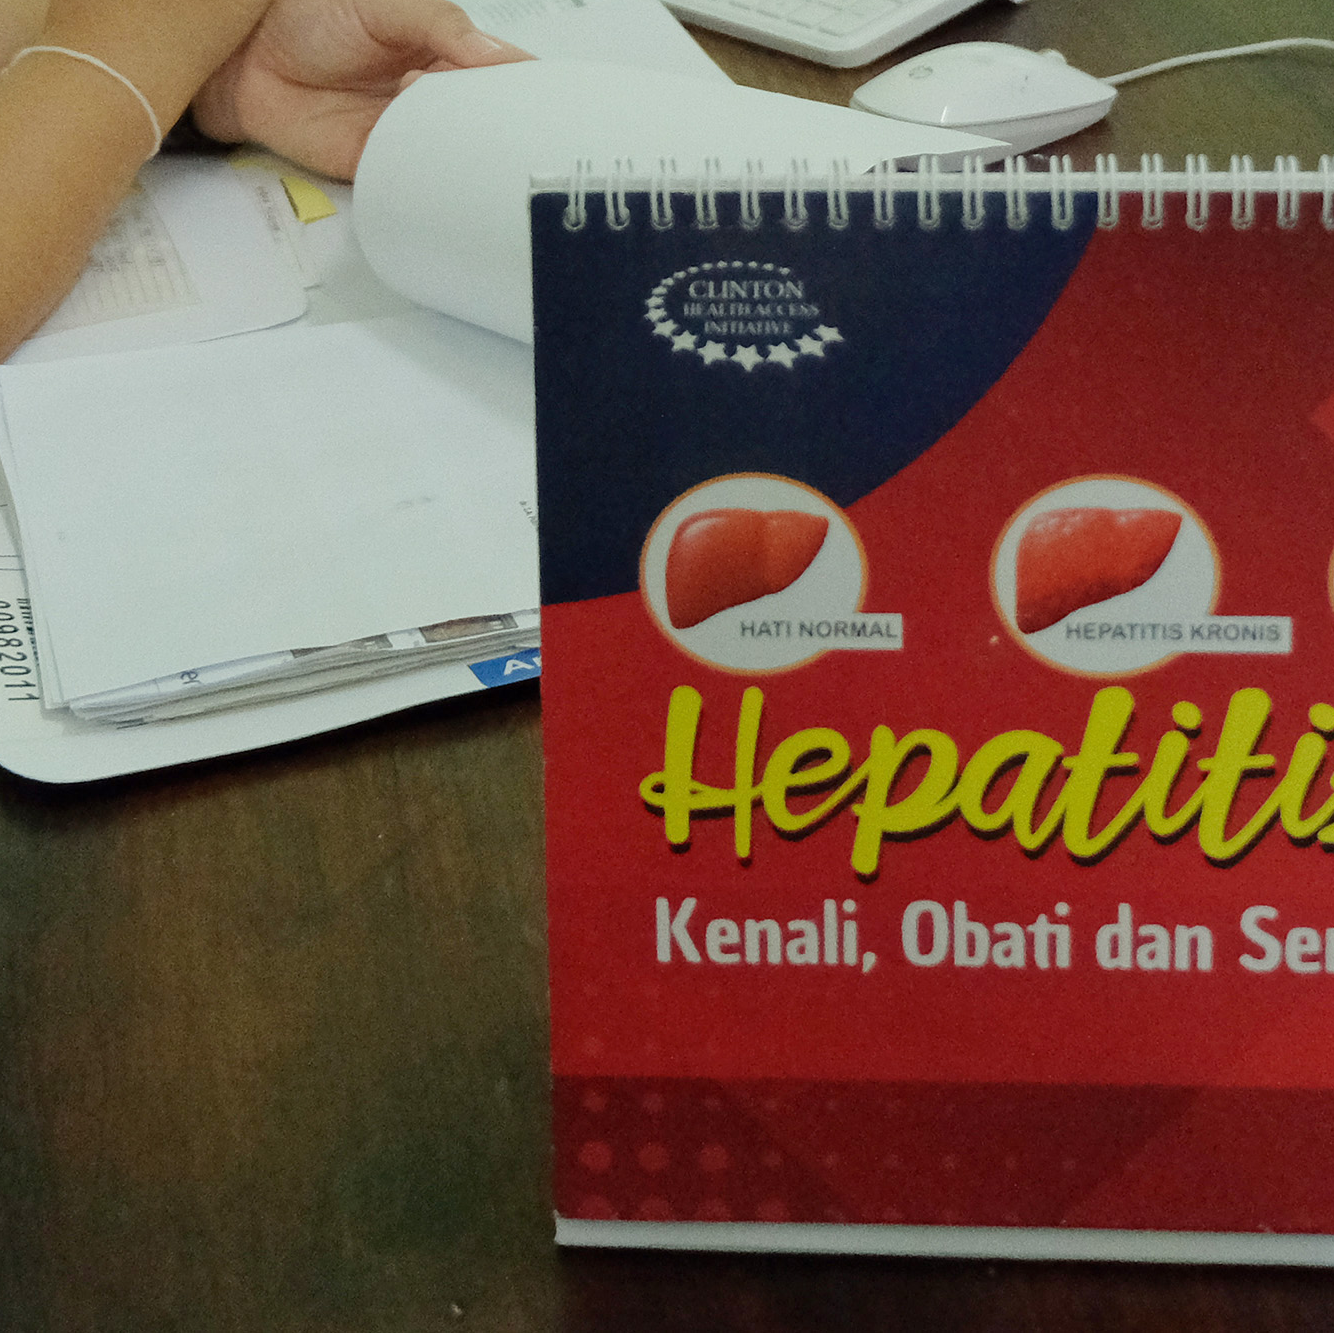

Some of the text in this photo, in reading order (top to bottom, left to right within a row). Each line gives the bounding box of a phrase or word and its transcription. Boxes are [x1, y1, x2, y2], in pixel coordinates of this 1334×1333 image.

[688, 280, 804, 299] CLINTON
[683, 302, 820, 317] HEALTH ACCESS
[704, 320, 793, 336] INITIATIVE
[740, 619, 898, 639] HATI NORMAL
[1067, 622, 1281, 642] HEPATITIS KRONIS
[654, 896, 877, 974] Kenali,
[900, 898, 1071, 969] Obati
[1095, 902, 1213, 971] dan
